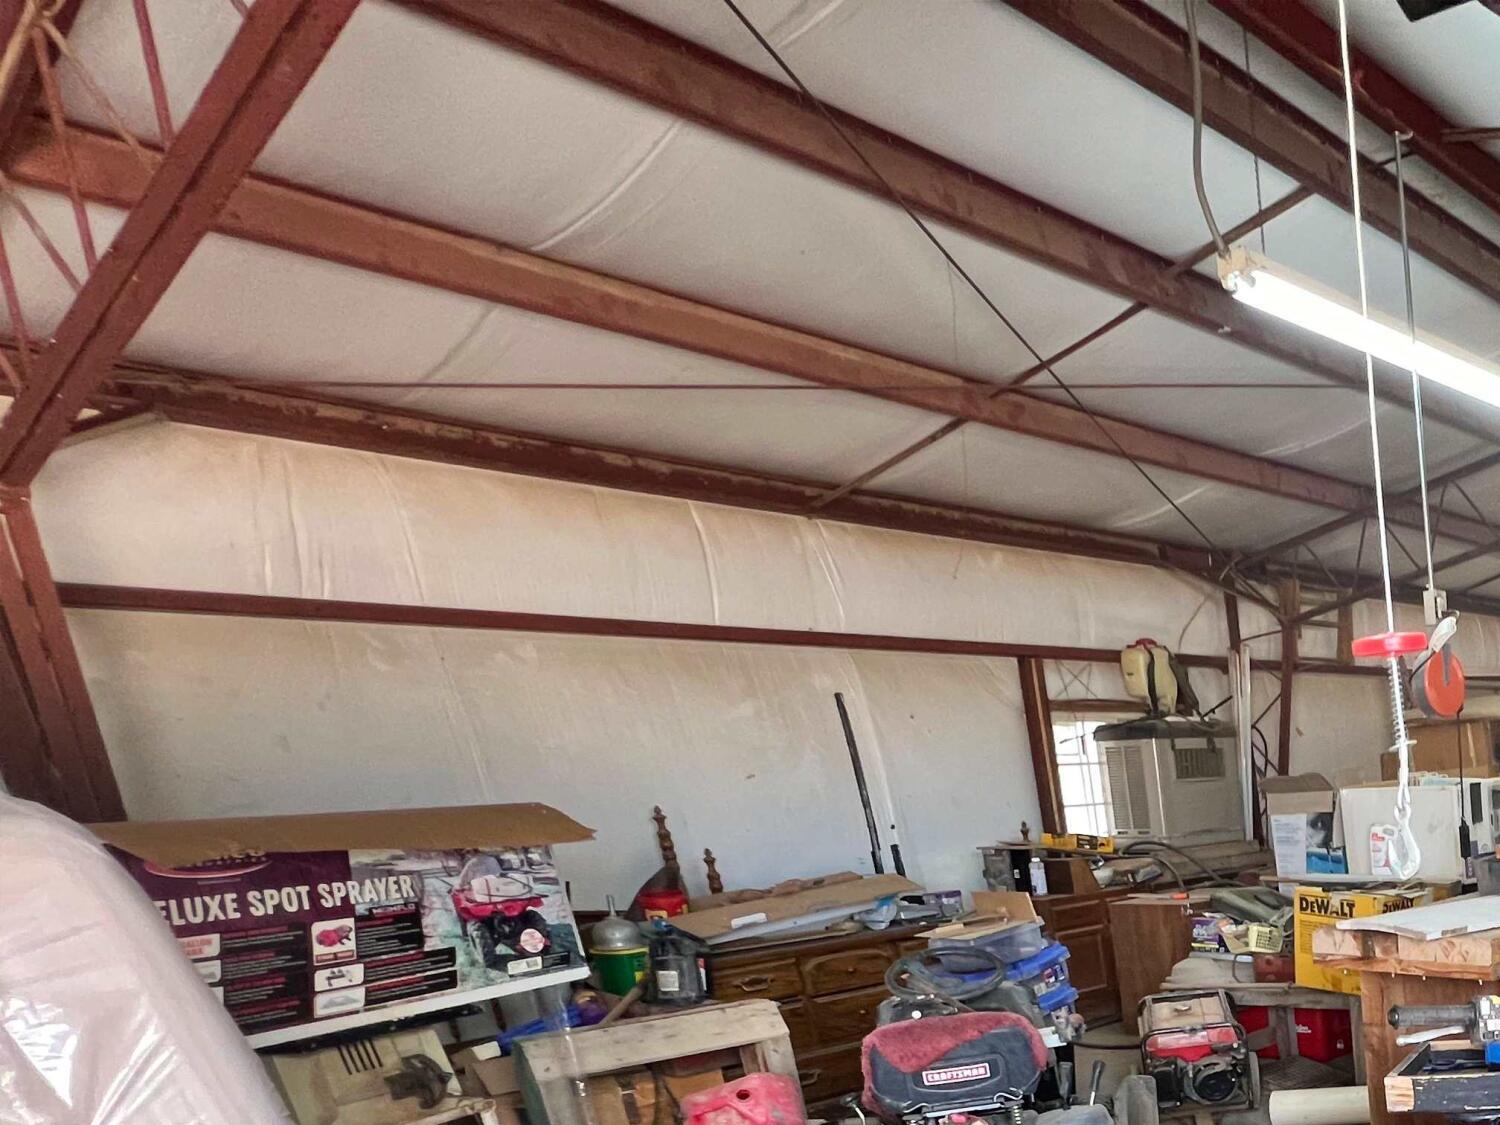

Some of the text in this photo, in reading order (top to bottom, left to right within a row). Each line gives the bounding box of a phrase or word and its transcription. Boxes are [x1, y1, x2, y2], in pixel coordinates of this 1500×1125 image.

[152, 875, 415, 926] ELUXE SPOT SPRAYER
[927, 1066, 987, 1082] CRAFTSMAN
